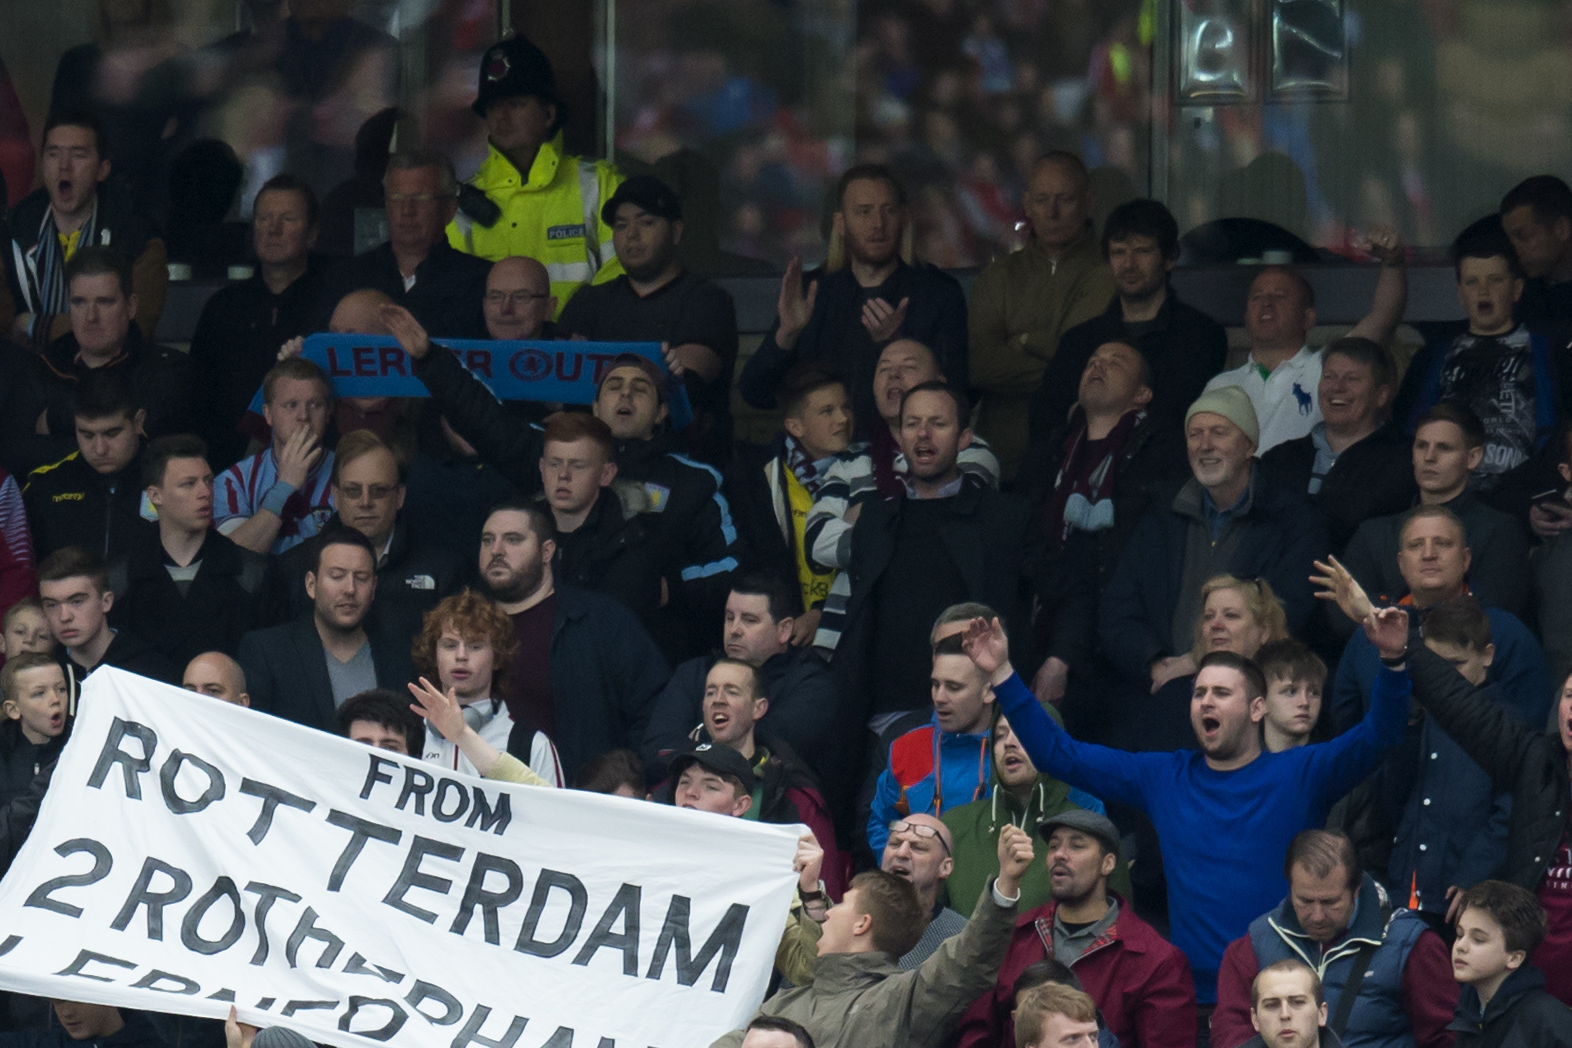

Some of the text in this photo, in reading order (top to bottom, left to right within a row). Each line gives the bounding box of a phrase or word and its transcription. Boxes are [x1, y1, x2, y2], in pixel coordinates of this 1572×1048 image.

[549, 229, 585, 239] POLICE
[327, 347, 493, 379] LERR
[359, 754, 513, 836] FROM
[23, 837, 114, 918] 2
[87, 716, 751, 993] ROTTERDAM
